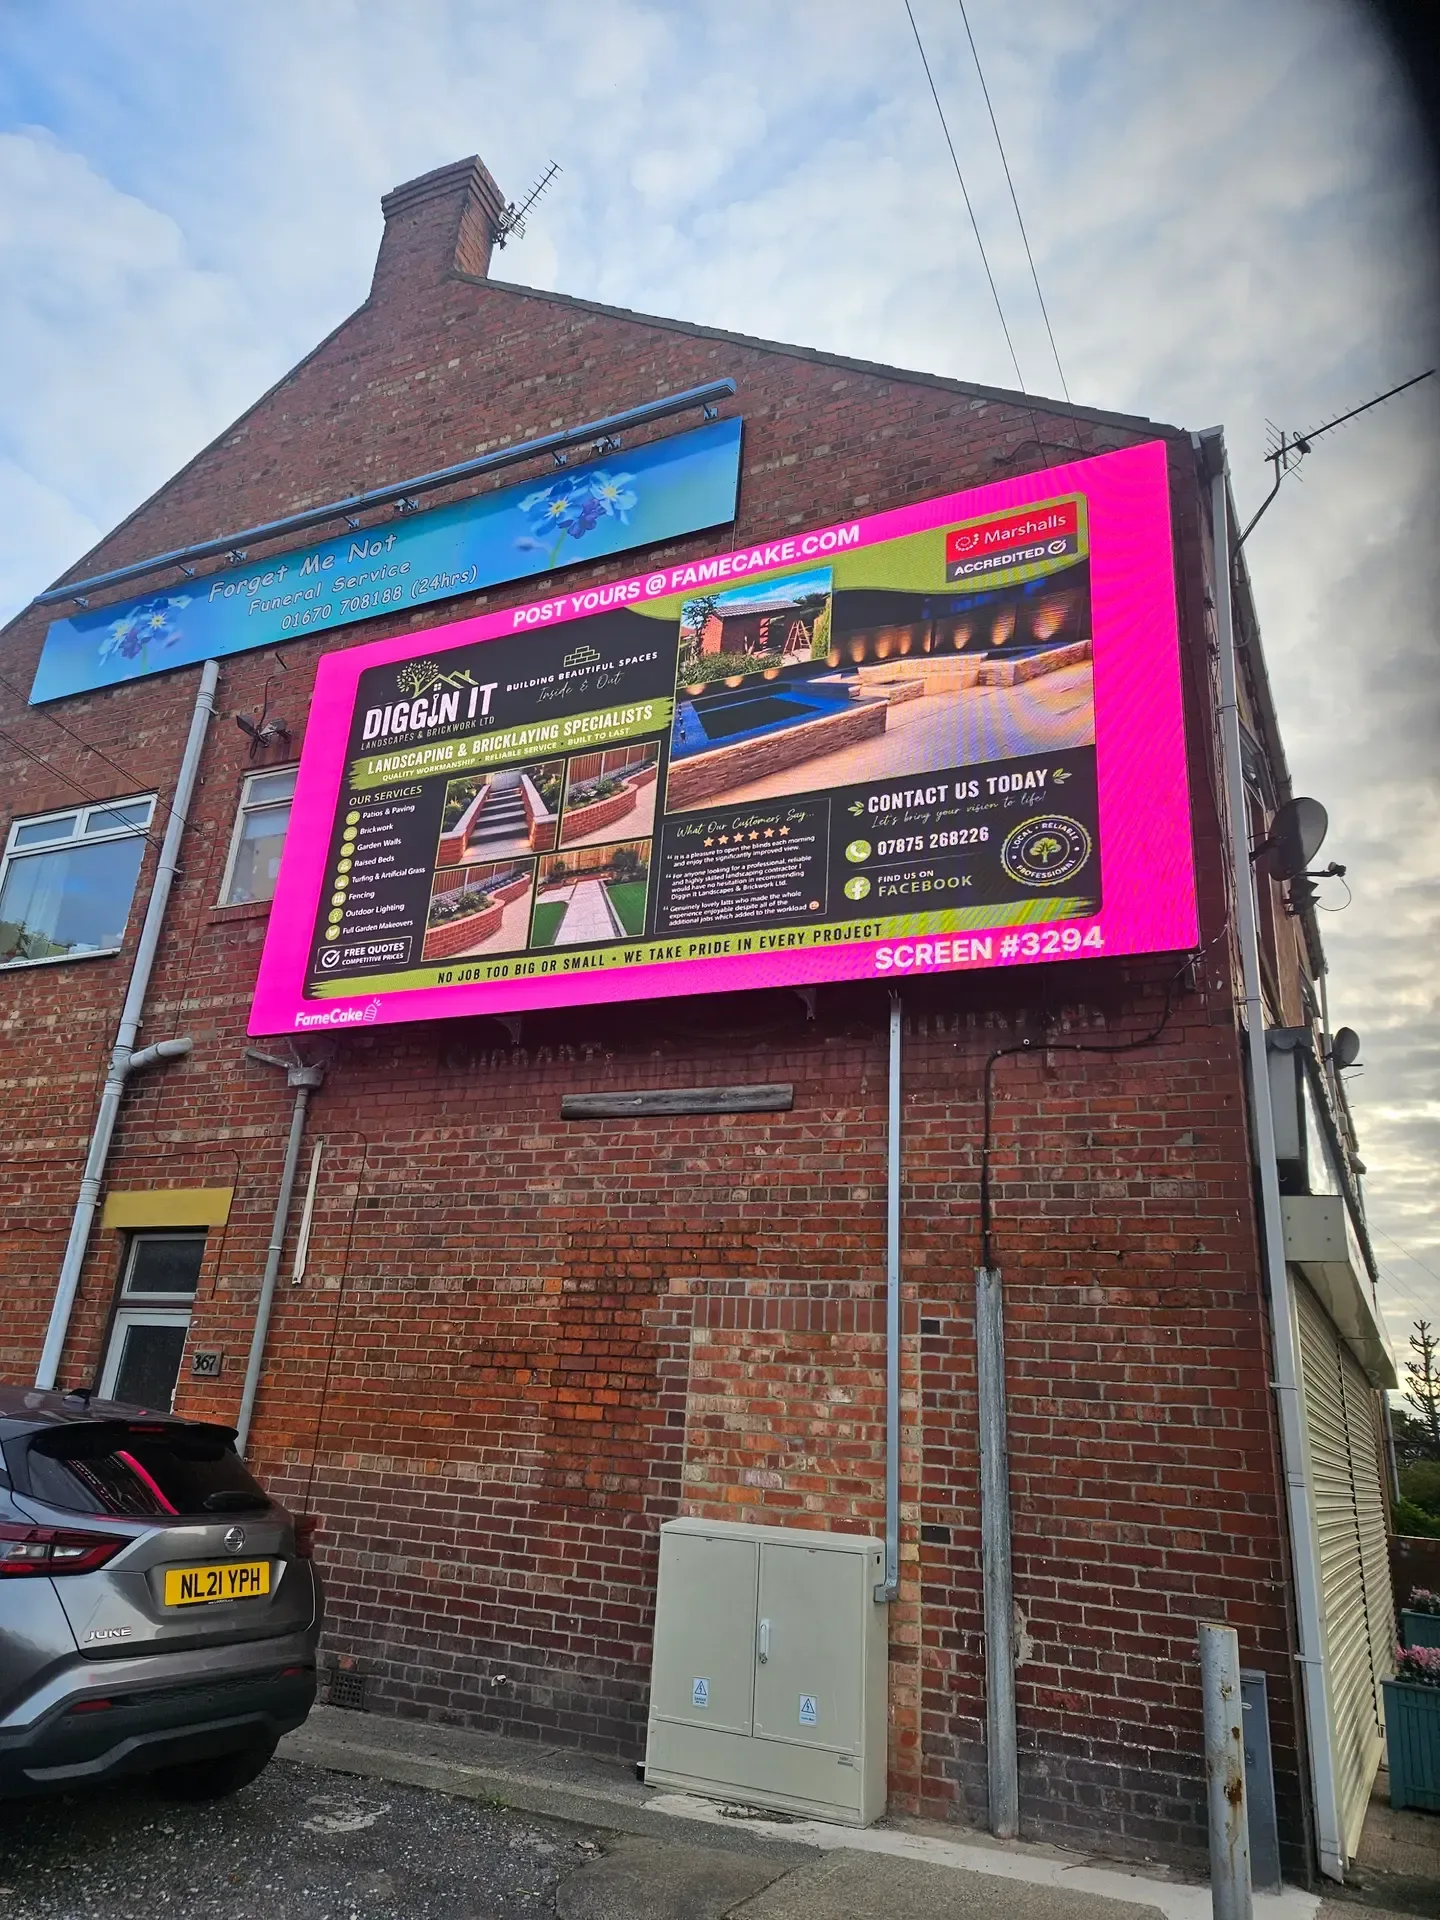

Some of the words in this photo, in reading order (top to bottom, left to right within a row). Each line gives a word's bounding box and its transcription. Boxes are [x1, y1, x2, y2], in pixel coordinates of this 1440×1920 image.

[984, 514, 1067, 544] Marshalls
[208, 564, 288, 603] Forget
[299, 553, 335, 577] Me
[348, 533, 397, 563] Not
[954, 547, 1045, 576] ACCREDITED
[512, 600, 566, 627] POST
[571, 580, 640, 612] YOURS
[645, 573, 667, 596] @
[671, 525, 860, 588] FAMECAKE.COM
[249, 581, 322, 616] Funeral
[331, 560, 411, 592] Service
[281, 603, 332, 631] 01670
[339, 585, 402, 615] 708188
[410, 565, 478, 599] (24hrs)
[506, 674, 555, 692] BUILDING
[558, 661, 615, 681] BEAUTIFUL
[618, 651, 658, 668] SPACES
[536, 684, 574, 703] Inside
[579, 681, 589, 693] &
[596, 671, 625, 690] Out
[467, 682, 498, 718] IT
[361, 731, 415, 751] LANDSCAPES
[417, 731, 423, 739] &
[426, 720, 476, 738] BRICKWORK
[479, 716, 495, 728] LTD
[367, 745, 453, 775] LANDSCAPING
[457, 743, 468, 757] &
[472, 724, 559, 754] BRICKLAYING
[563, 705, 653, 736] SPECIALISTS
[382, 769, 415, 782] QUALITY
[416, 758, 476, 775] WORKMANSHIP
[484, 748, 521, 762] RELIABLE
[523, 742, 557, 755] SERVICE
[567, 734, 592, 746] BUILT
[594, 732, 606, 741] TO
[608, 727, 631, 738] LAST
[349, 795, 372, 806] OUR
[373, 785, 423, 802] SERVICES
[867, 785, 949, 814] CONTACT
[955, 780, 980, 800] US
[986, 768, 1049, 795] TODAY
[362, 810, 383, 819] Patios
[391, 804, 415, 814] Paving
[871, 814, 899, 829] Let's
[904, 809, 931, 825] bring
[936, 808, 961, 822] your
[966, 802, 999, 814] vision
[1003, 796, 1015, 809] to
[1020, 790, 1047, 807] life!
[359, 823, 394, 835] Brickwork
[676, 823, 706, 838] What
[707, 820, 727, 833] Our
[732, 814, 781, 830] Customers
[356, 841, 382, 852] Garden
[383, 837, 402, 847] Walls
[690, 850, 716, 860] pleasure
[724, 846, 740, 855] open
[752, 841, 771, 849] blinds
[787, 835, 815, 844] morning
[877, 835, 924, 856] 07875
[929, 826, 990, 849] 268226
[1011, 828, 1033, 849] LOCAL
[354, 857, 377, 867] Raised
[378, 854, 395, 863] Beds
[673, 860, 685, 868] and
[686, 858, 703, 867] enjoy
[715, 852, 752, 862] significantly
[752, 847, 783, 857] improved
[683, 870, 706, 878] anyone
[707, 866, 730, 875] looking
[787, 855, 812, 863] reliable
[351, 874, 374, 884] Turfing
[380, 868, 407, 879] Artificial
[407, 866, 426, 875] Grass
[684, 877, 704, 885] highly
[725, 868, 764, 879] landscaping
[764, 864, 798, 874] contractor
[878, 874, 901, 883] FIND
[903, 872, 916, 880] US
[919, 869, 934, 878] ON
[1016, 859, 1076, 879] PROFESSIONAL
[670, 892, 691, 900] Diggin
[698, 886, 734, 897] Landscapes
[742, 881, 774, 891] Brickwork
[671, 885, 691, 893] would
[716, 878, 748, 887] hesitation
[755, 871, 805, 881] recommending
[878, 875, 972, 897] FACEBOOK
[348, 890, 376, 901] Fencing
[669, 903, 700, 912] Genuinely
[750, 894, 769, 902] made
[345, 907, 375, 918] Outdoor
[375, 903, 405, 914] Lighting
[668, 917, 700, 926] additional
[700, 916, 714, 924] jobs
[714, 913, 734, 921] which
[734, 910, 755, 918] added
[776, 904, 807, 913] workload
[669, 911, 703, 920] experience
[703, 906, 734, 916] enjoyable
[734, 903, 759, 911] despite
[342, 926, 355, 935] Full
[355, 922, 378, 932] Garden
[378, 919, 413, 930] Makeovers
[341, 954, 382, 966] COMPETITIVE
[382, 952, 404, 961] PRICES
[344, 947, 366, 958] FREE
[367, 942, 405, 955] QUOTES
[437, 971, 453, 984] NO
[457, 969, 480, 981] JOB
[486, 965, 509, 979] TOO
[514, 962, 535, 976] BIG
[541, 960, 557, 973] OR
[563, 954, 605, 970] SMALL
[623, 950, 642, 963] WE
[649, 946, 682, 961] TAKE
[688, 940, 731, 957] PRIDE
[737, 938, 752, 950] IN
[759, 932, 805, 949] EVERY
[813, 923, 883, 943] PROJECT
[874, 936, 993, 971] SCREEN
[999, 925, 1105, 958] #3294
[294, 1007, 363, 1027] FameCake
[192, 1354, 217, 1371] 367
[181, 1571, 223, 1599] NL21
[228, 1568, 260, 1594] YPH
[84, 1626, 132, 1643] JUKE
